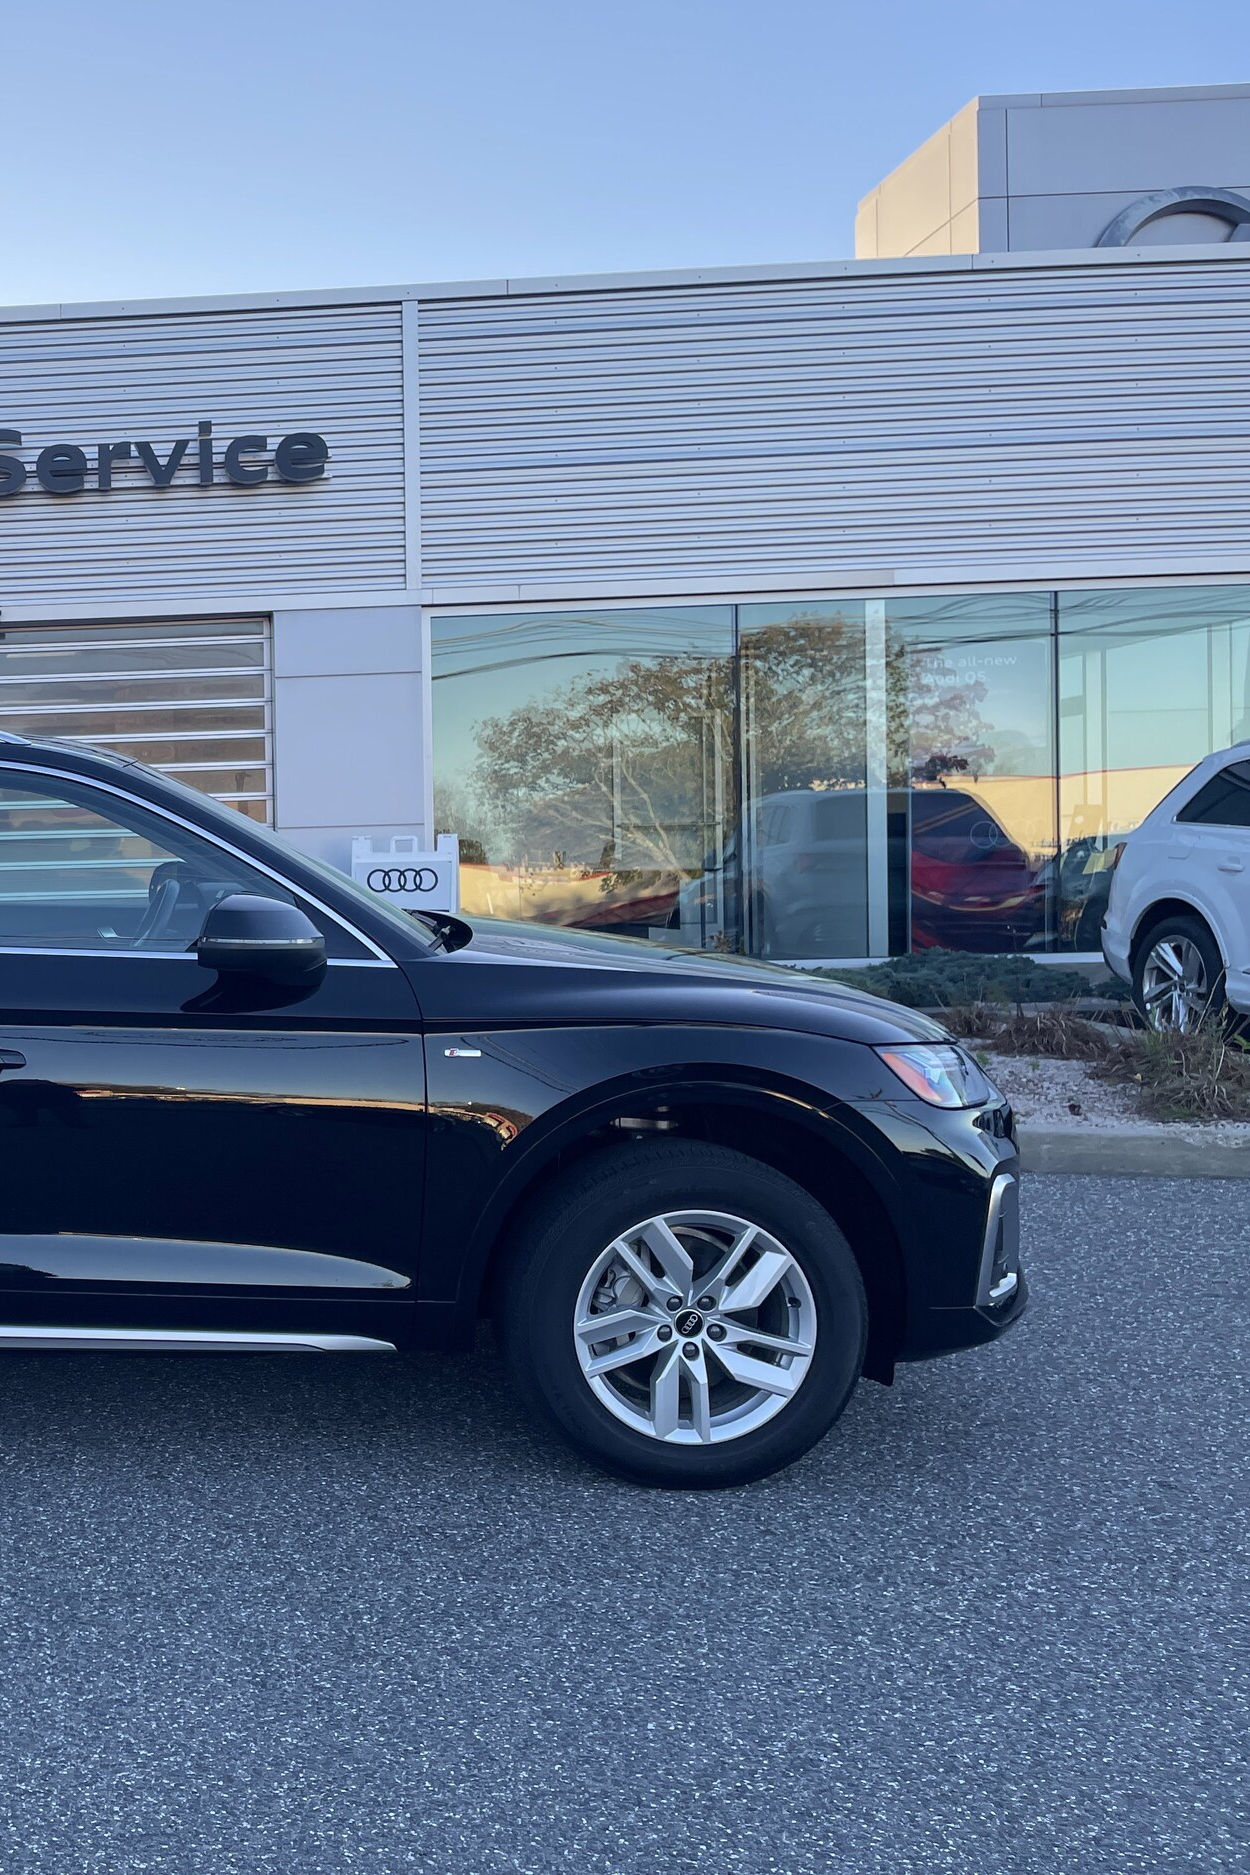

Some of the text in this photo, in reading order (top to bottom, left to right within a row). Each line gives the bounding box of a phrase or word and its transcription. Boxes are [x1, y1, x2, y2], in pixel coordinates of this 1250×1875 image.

[924, 655, 1017, 669] The all-new
[922, 672, 961, 685] Audi
